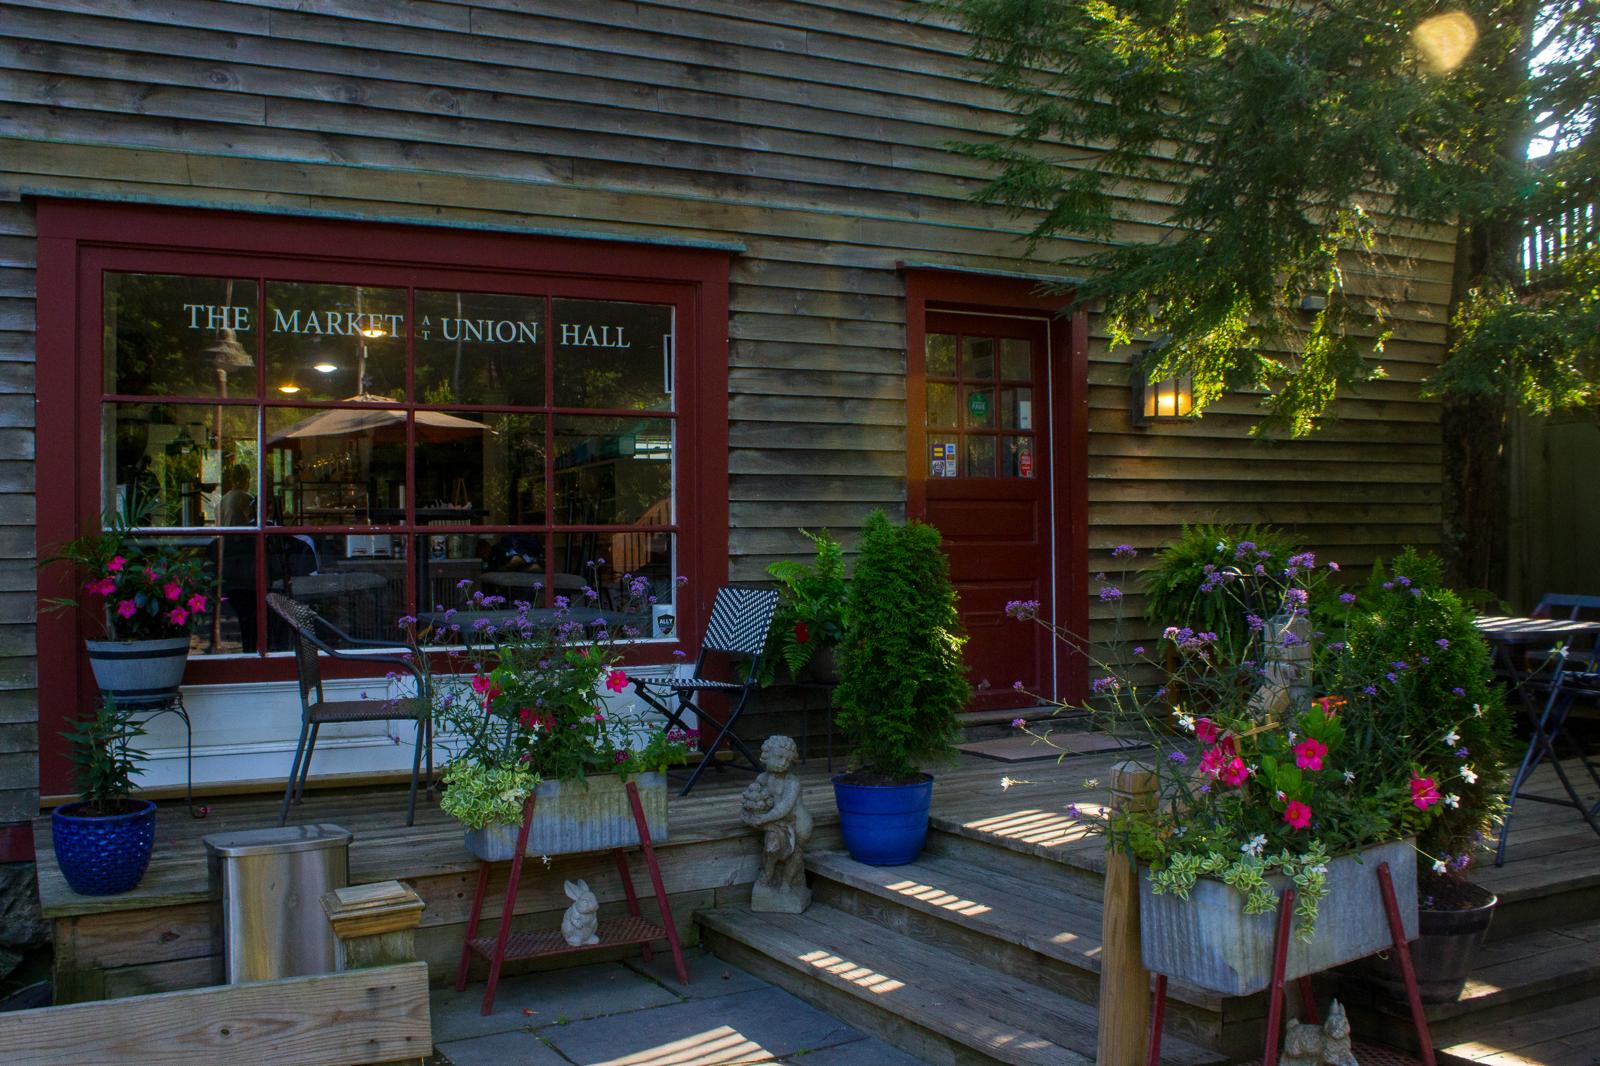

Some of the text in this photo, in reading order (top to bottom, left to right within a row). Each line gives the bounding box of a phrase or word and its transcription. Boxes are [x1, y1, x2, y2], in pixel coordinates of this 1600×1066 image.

[183, 303, 251, 331] THE
[272, 308, 404, 338] MARKET
[441, 317, 539, 344] UNION
[560, 323, 631, 349] HALL
